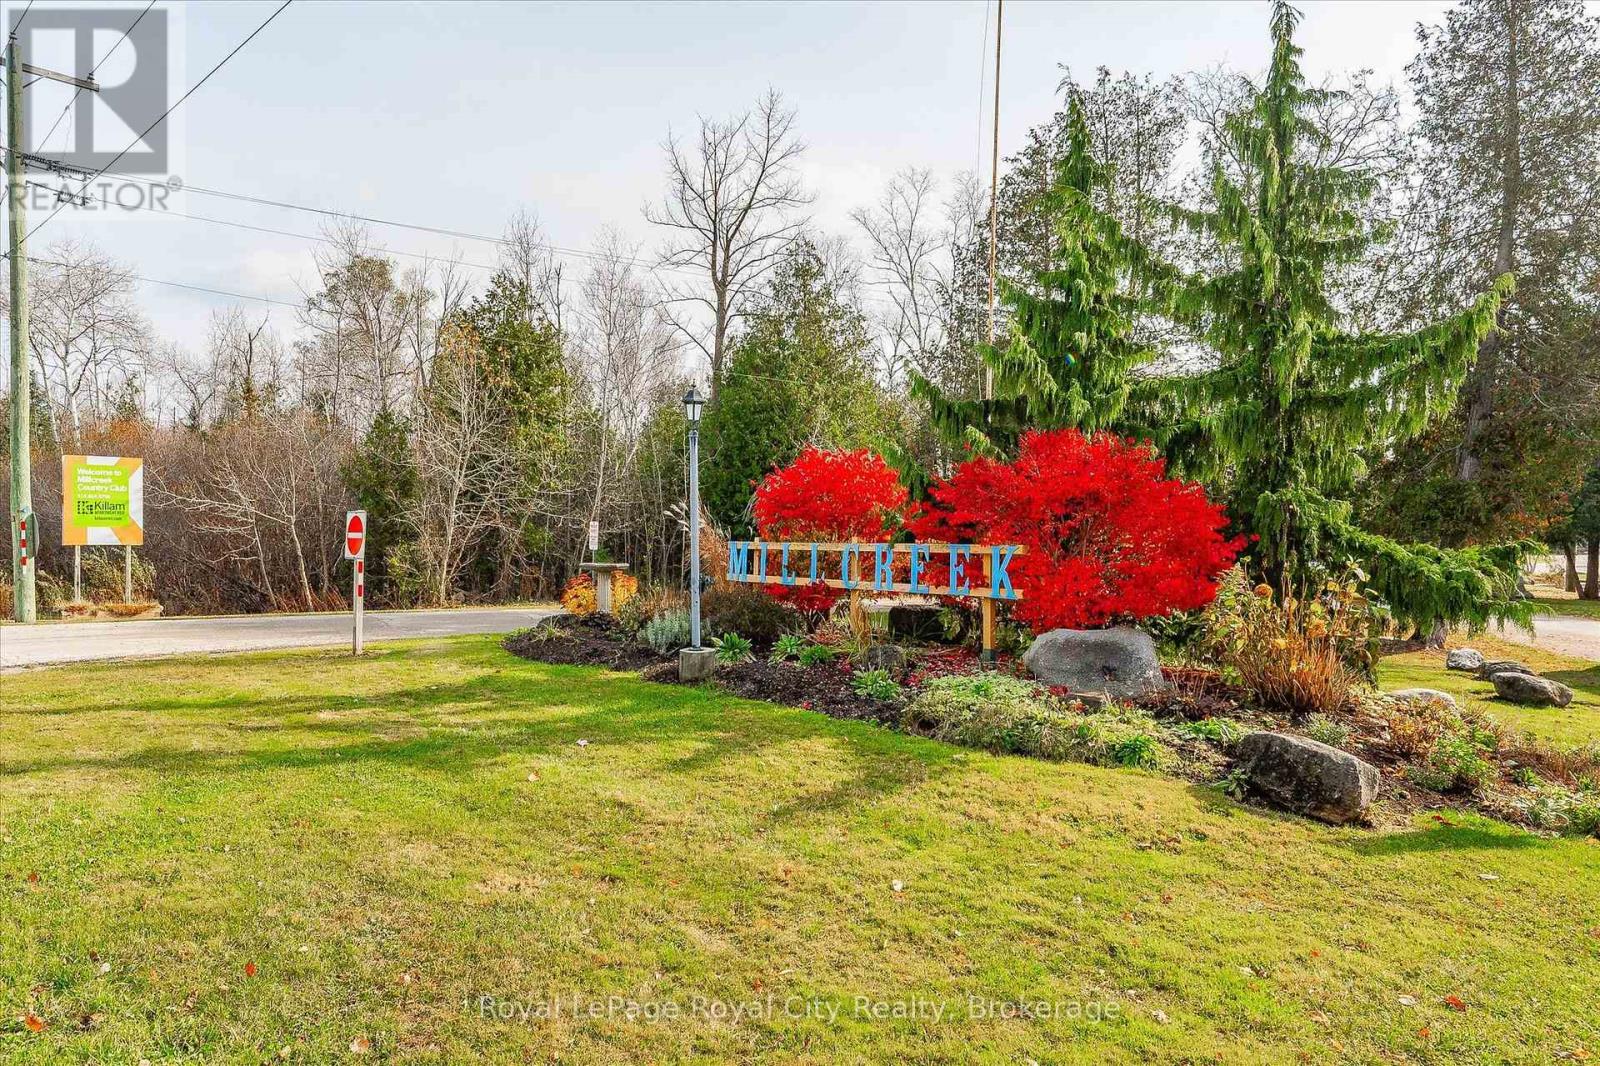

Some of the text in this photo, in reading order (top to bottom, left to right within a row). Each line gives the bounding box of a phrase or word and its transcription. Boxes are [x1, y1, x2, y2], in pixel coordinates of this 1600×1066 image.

[77, 468, 122, 477] Welcome to
[77, 484, 109, 493] Country
[94, 501, 126, 511] Killam
[728, 541, 1019, 599] MILLCREEK
